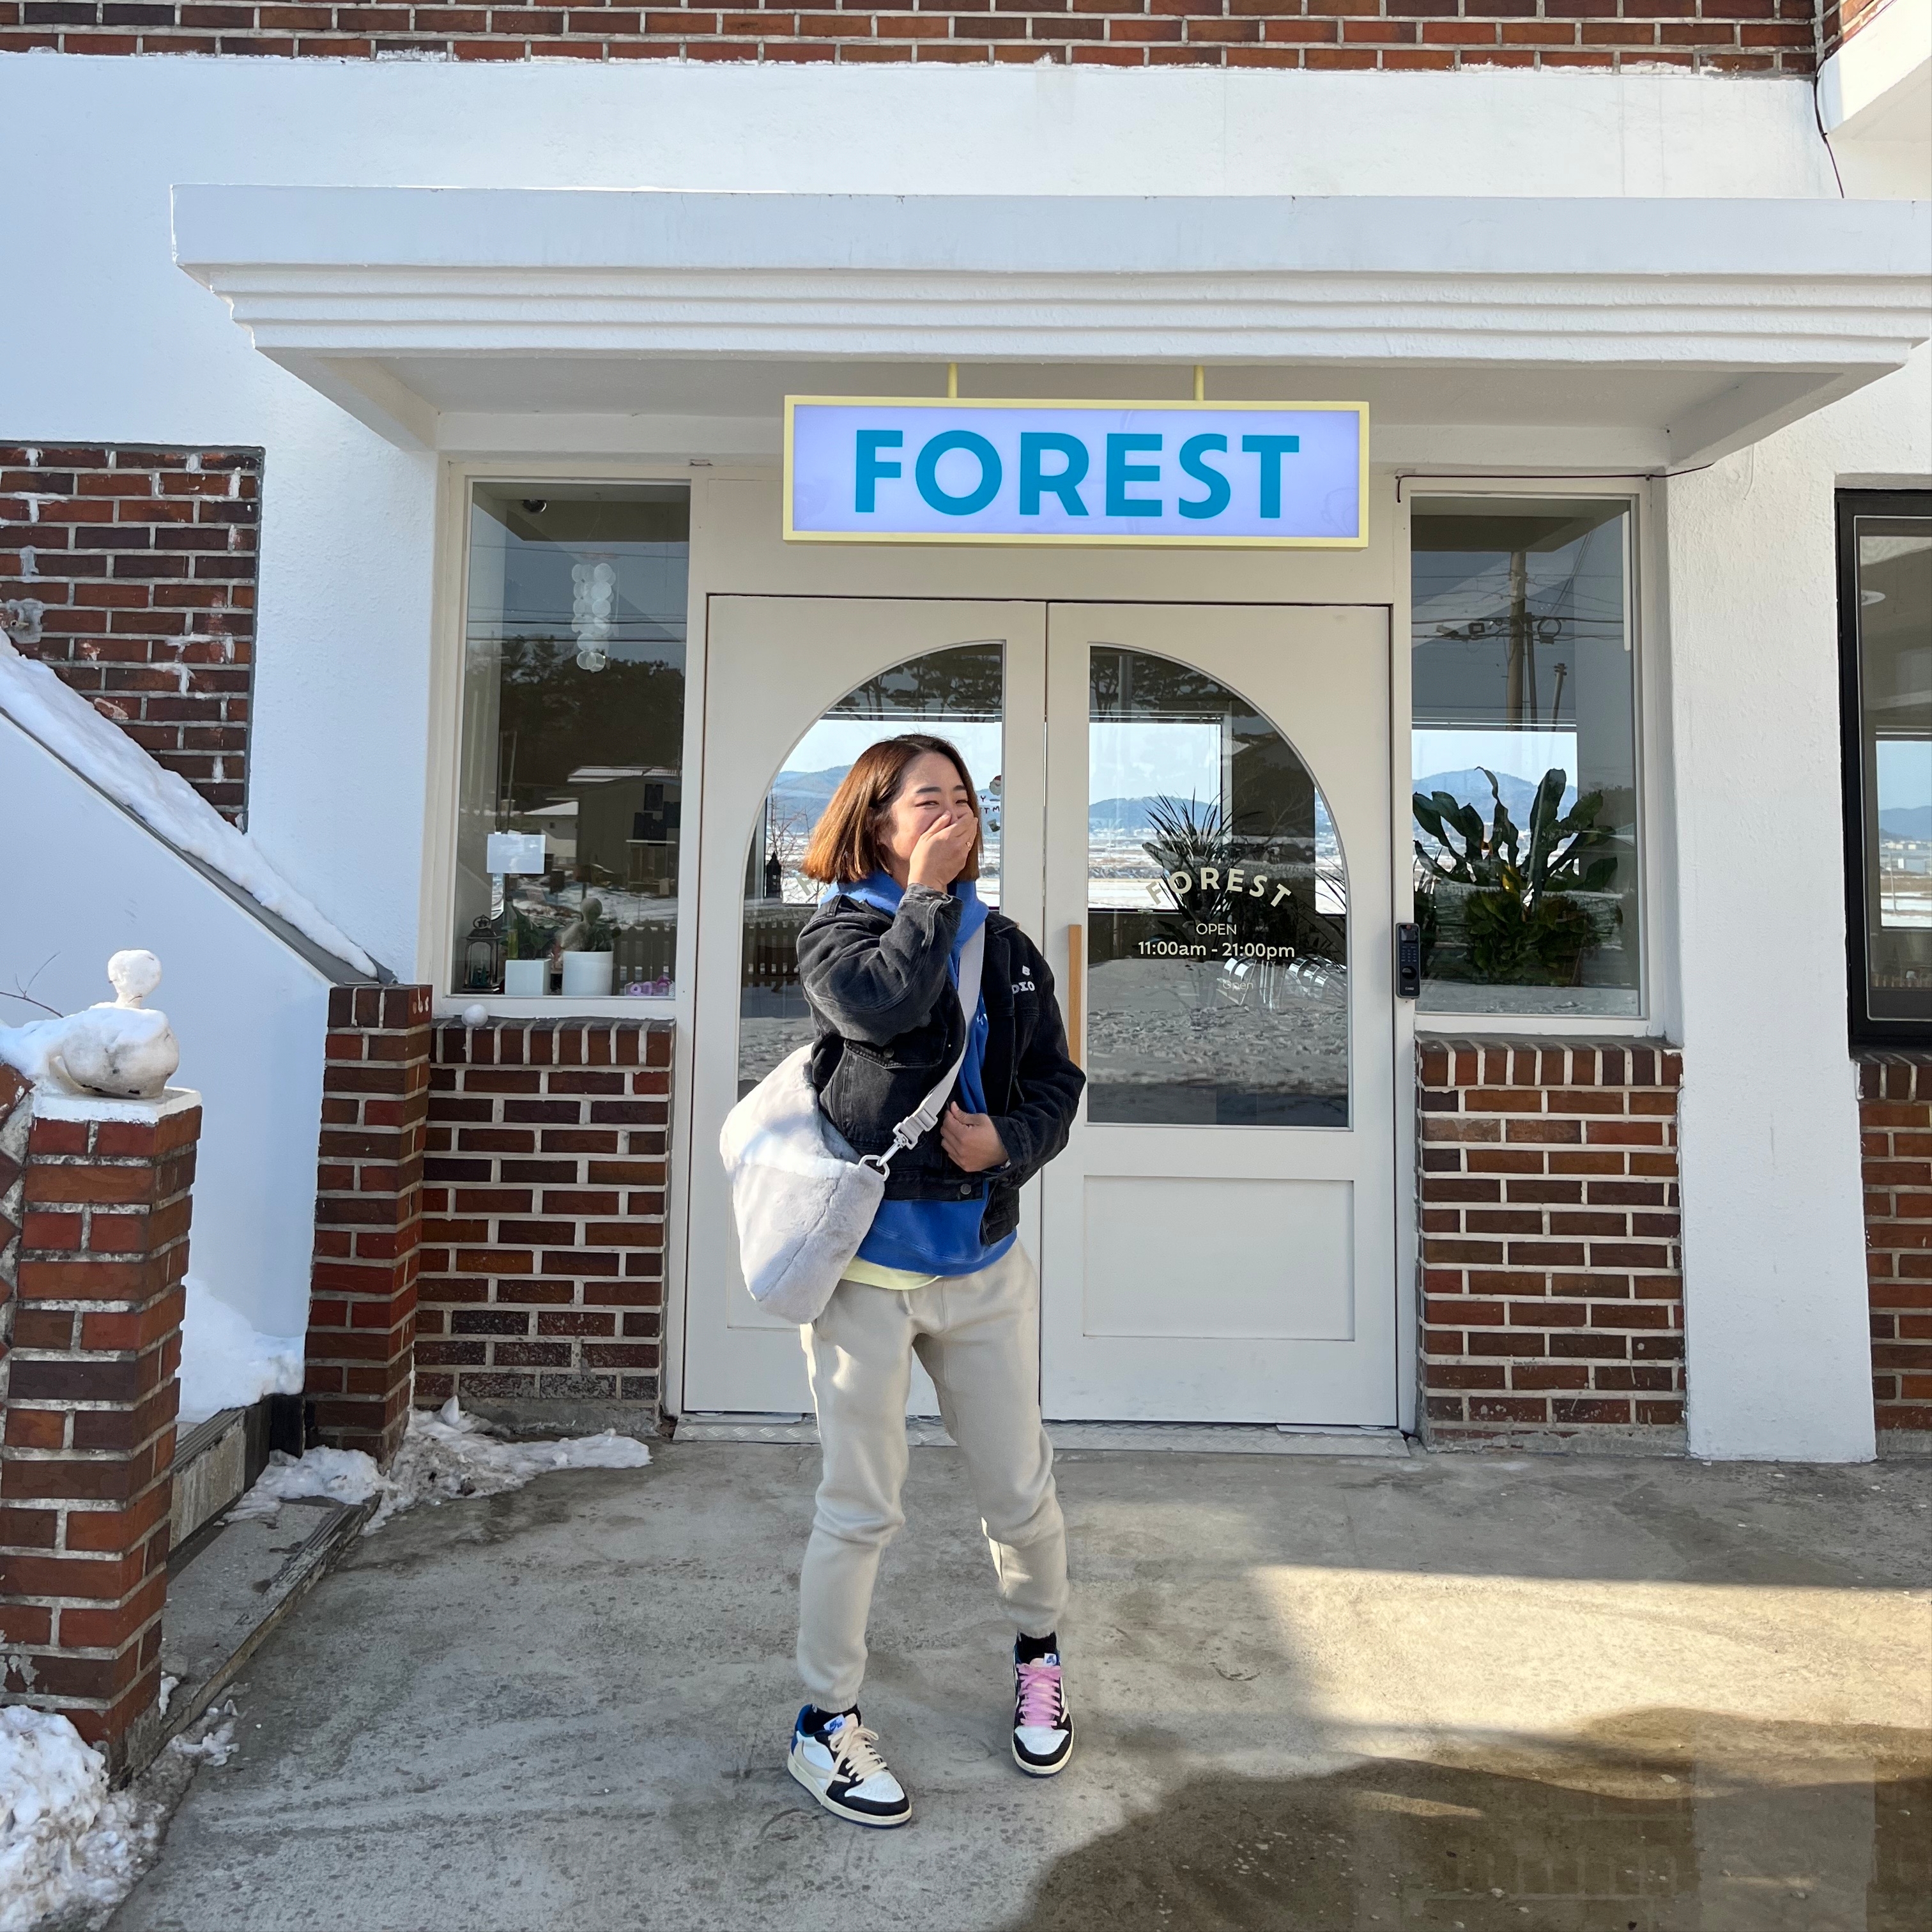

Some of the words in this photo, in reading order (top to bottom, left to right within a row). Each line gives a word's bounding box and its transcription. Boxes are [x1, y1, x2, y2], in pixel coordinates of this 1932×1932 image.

[855, 429, 1300, 519] FOREST
[1145, 867, 1291, 907] FOREST
[1196, 923, 1237, 935] OPEN
[1138, 941, 1206, 956] 11:00am
[1222, 942, 1295, 960] 21:00pm
[1223, 980, 1254, 991] Open
